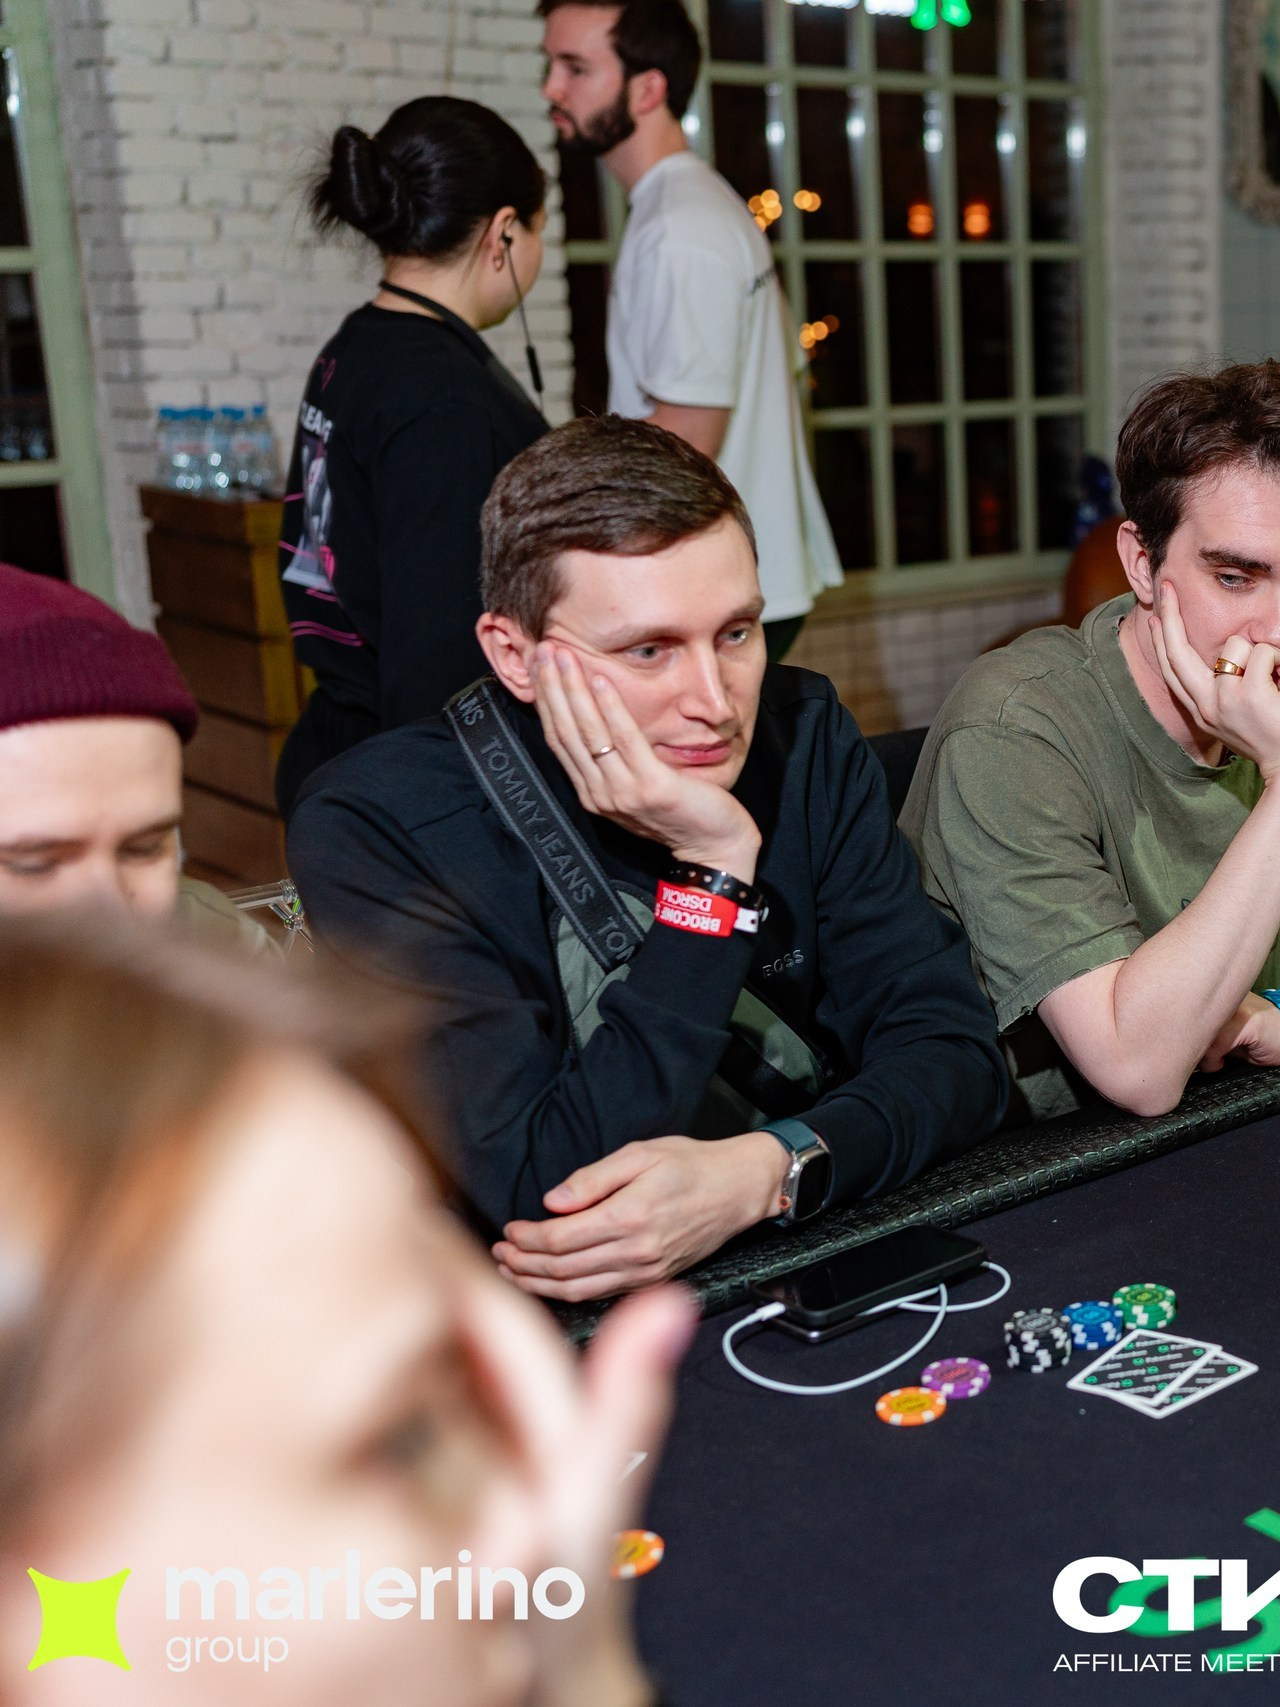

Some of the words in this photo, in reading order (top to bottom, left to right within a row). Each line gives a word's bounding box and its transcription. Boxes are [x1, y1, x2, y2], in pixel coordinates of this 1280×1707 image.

[481, 735, 548, 826] TOMMY
[533, 828, 595, 905] JEANS
[660, 906, 722, 933] BROCONF
[762, 949, 805, 978] BOSS
